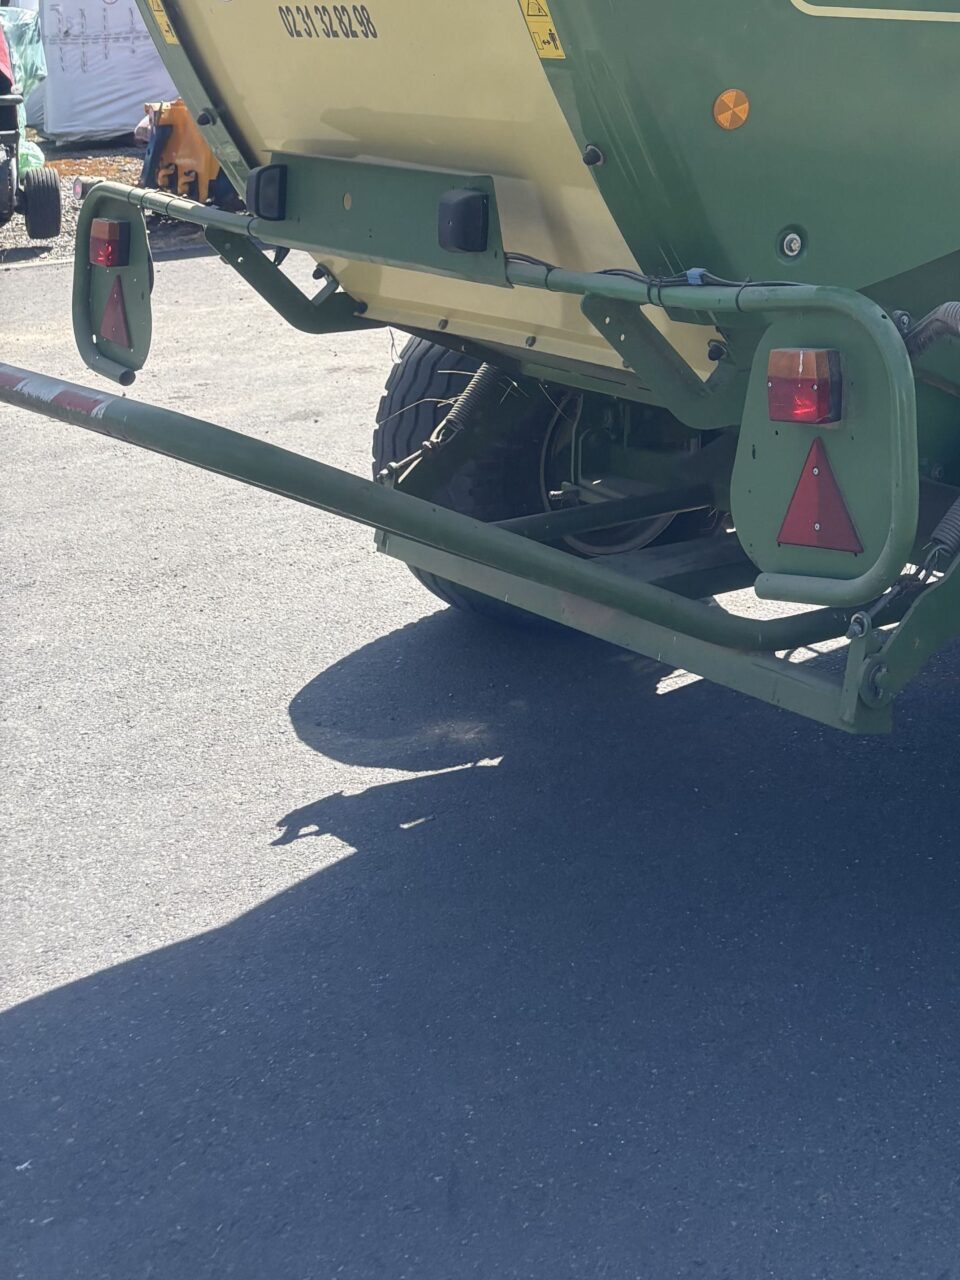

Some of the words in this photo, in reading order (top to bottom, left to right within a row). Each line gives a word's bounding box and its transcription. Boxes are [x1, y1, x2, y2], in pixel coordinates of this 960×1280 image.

[278, 5, 303, 38] 02
[296, 5, 320, 38] 31
[314, 5, 340, 38] 32
[333, 4, 359, 38] 82
[352, 4, 378, 39] 98
